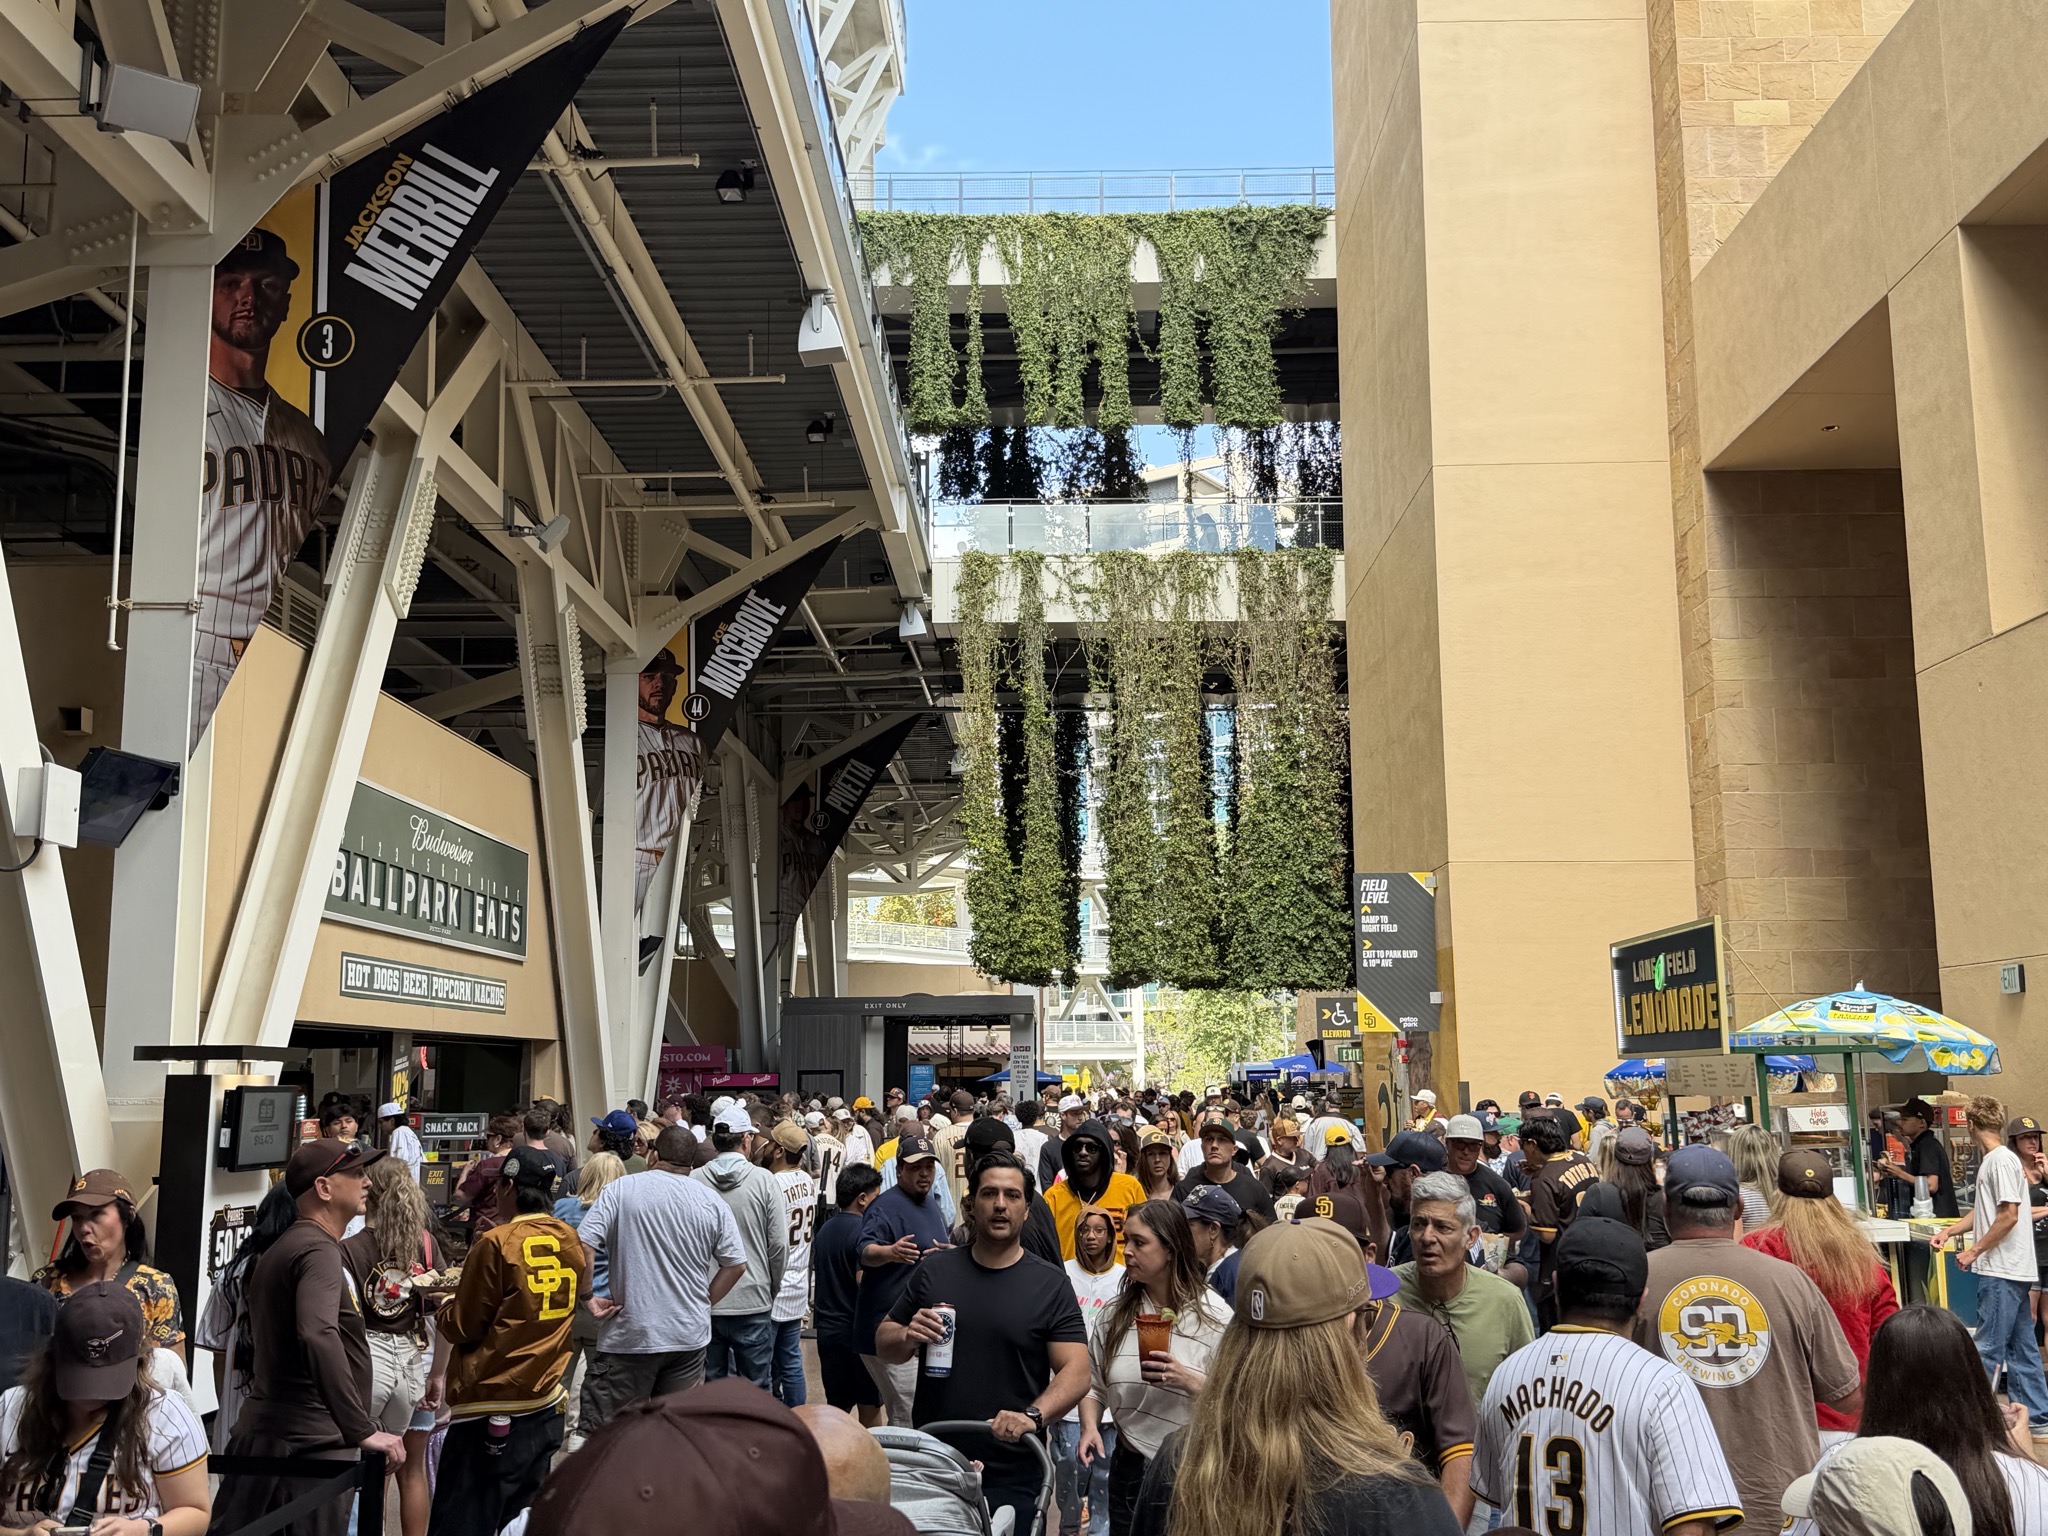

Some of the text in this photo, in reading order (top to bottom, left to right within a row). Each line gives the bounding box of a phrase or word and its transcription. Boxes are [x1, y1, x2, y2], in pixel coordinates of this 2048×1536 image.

[344, 153, 413, 249] JACKSON
[344, 143, 500, 311] MERRILL
[322, 324, 333, 359] 3
[697, 588, 787, 700] MUSGROVE
[712, 622, 729, 644] JOE
[691, 698, 703, 717] 44
[825, 758, 877, 815] PIVETTA
[828, 768, 843, 787] NICK
[816, 814, 825, 827] 27
[410, 814, 473, 867] Budweiser
[331, 851, 521, 942] BALLPARK EATS
[1361, 879, 1388, 891] FIELD
[1361, 892, 1389, 904] LEVEL
[1361, 915, 1388, 924] RAMP TO
[1361, 924, 1398, 933] RIGHT FIELD
[1363, 950, 1418, 958] EXIT TO PARK BLVD
[1363, 959, 1369, 967] &
[1381, 959, 1393, 967] AVE
[1666, 948, 1697, 976] FIELD
[347, 962, 505, 1006] HOT DOGS BEER POPCORN NACHOS
[2002, 967, 2017, 990] EXIT
[1364, 1012, 1376, 1028] SD
[1621, 982, 1719, 1036] LEMONADE
[1322, 1029, 1351, 1038] ELEVATOR
[1342, 1049, 1360, 1061] EXIT
[392, 1070, 409, 1099] 10%
[712, 1074, 731, 1086] Puesto
[752, 1073, 771, 1085] Puesto
[1810, 1108, 1827, 1119] Hola
[425, 1121, 479, 1133] SNACK RACK
[917, 1138, 929, 1151] SD
[428, 1170, 444, 1178] EXIT
[1558, 1163, 1590, 1190] TATIS
[783, 1182, 809, 1204] TATIS
[1315, 1196, 1334, 1219] SD
[789, 1204, 815, 1247] 23
[522, 1235, 578, 1321] SD
[1672, 1281, 1750, 1307] CORONADO
[1679, 1305, 1750, 1357] SD
[1676, 1354, 1736, 1382] BREWING
[1500, 1375, 1614, 1434] MACHADO
[1514, 1433, 1586, 1536] 13
